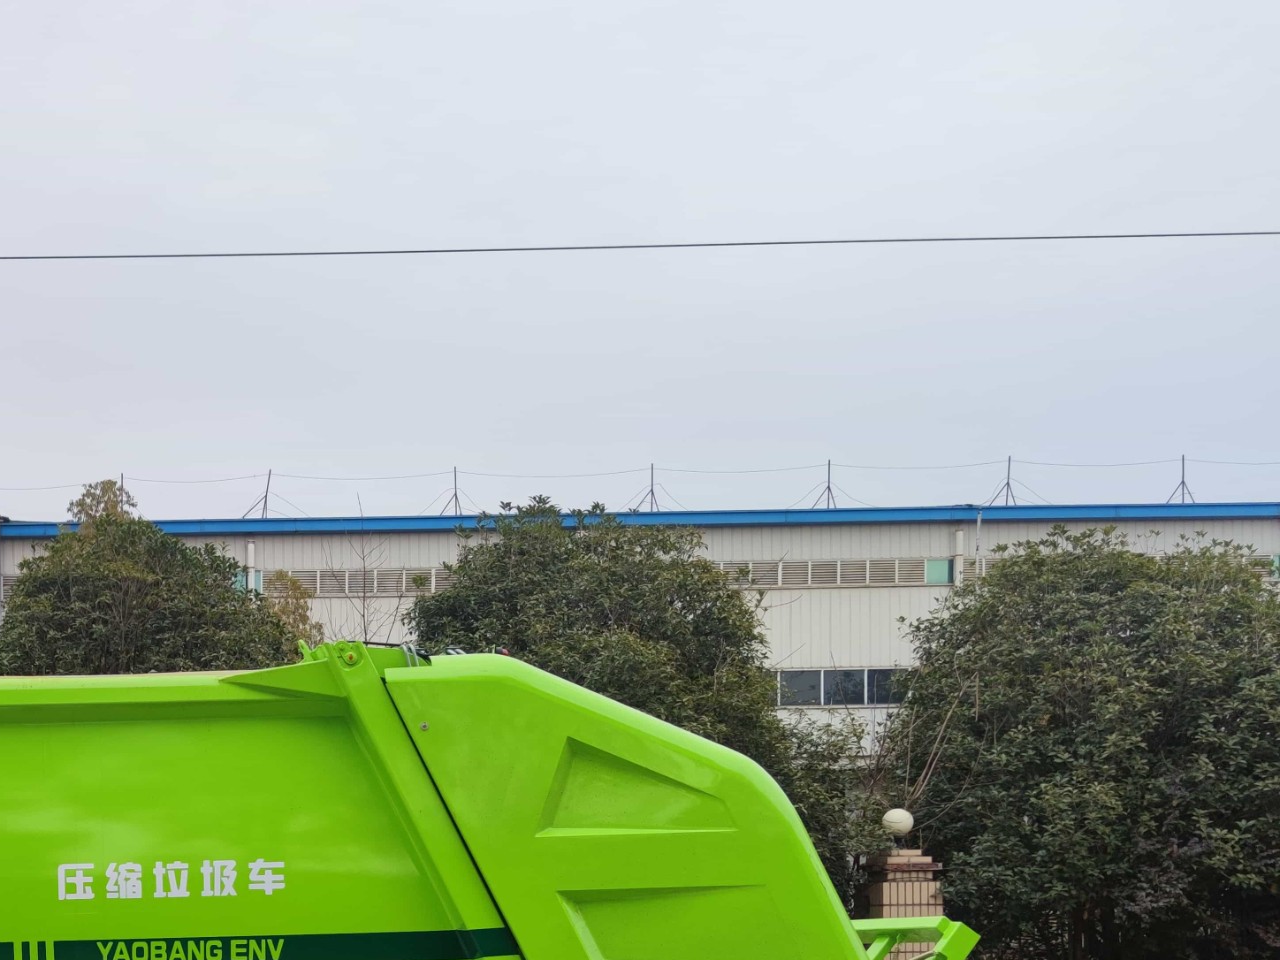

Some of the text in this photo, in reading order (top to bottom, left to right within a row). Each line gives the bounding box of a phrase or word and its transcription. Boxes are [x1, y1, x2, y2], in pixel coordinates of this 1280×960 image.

[57, 858, 286, 901] 压缩垃圾车
